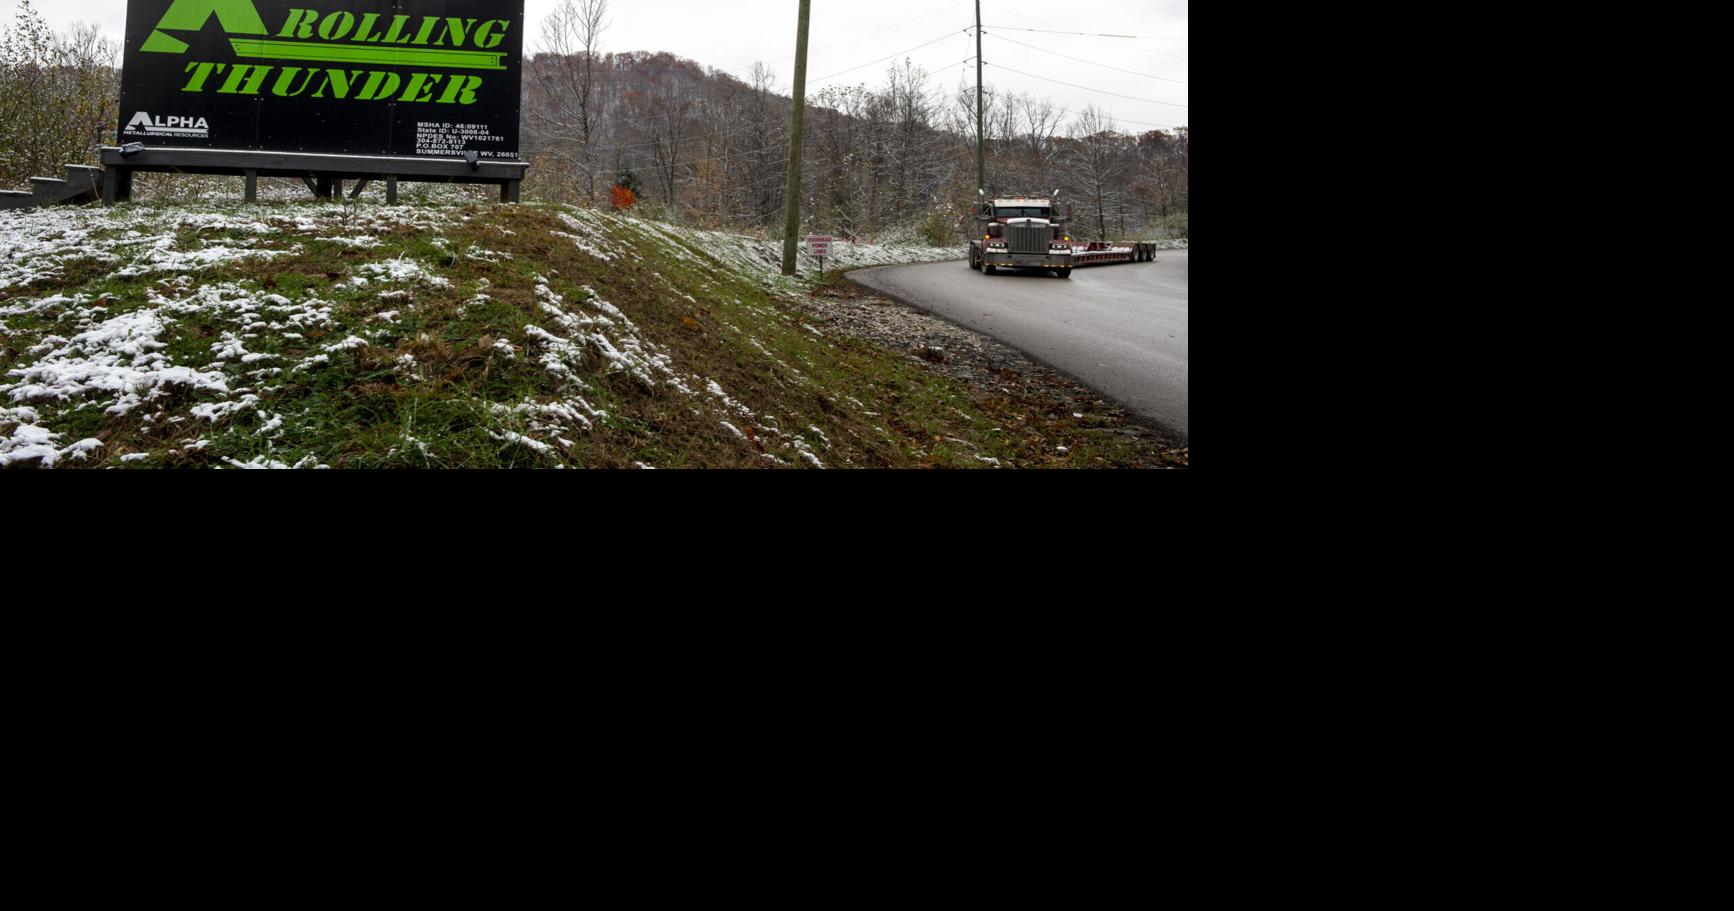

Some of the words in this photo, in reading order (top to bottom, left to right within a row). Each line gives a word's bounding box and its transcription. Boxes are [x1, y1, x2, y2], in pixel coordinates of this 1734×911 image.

[276, 9, 511, 48] ROLLING
[181, 62, 483, 104] THUNDER
[125, 111, 209, 130] ALPHA
